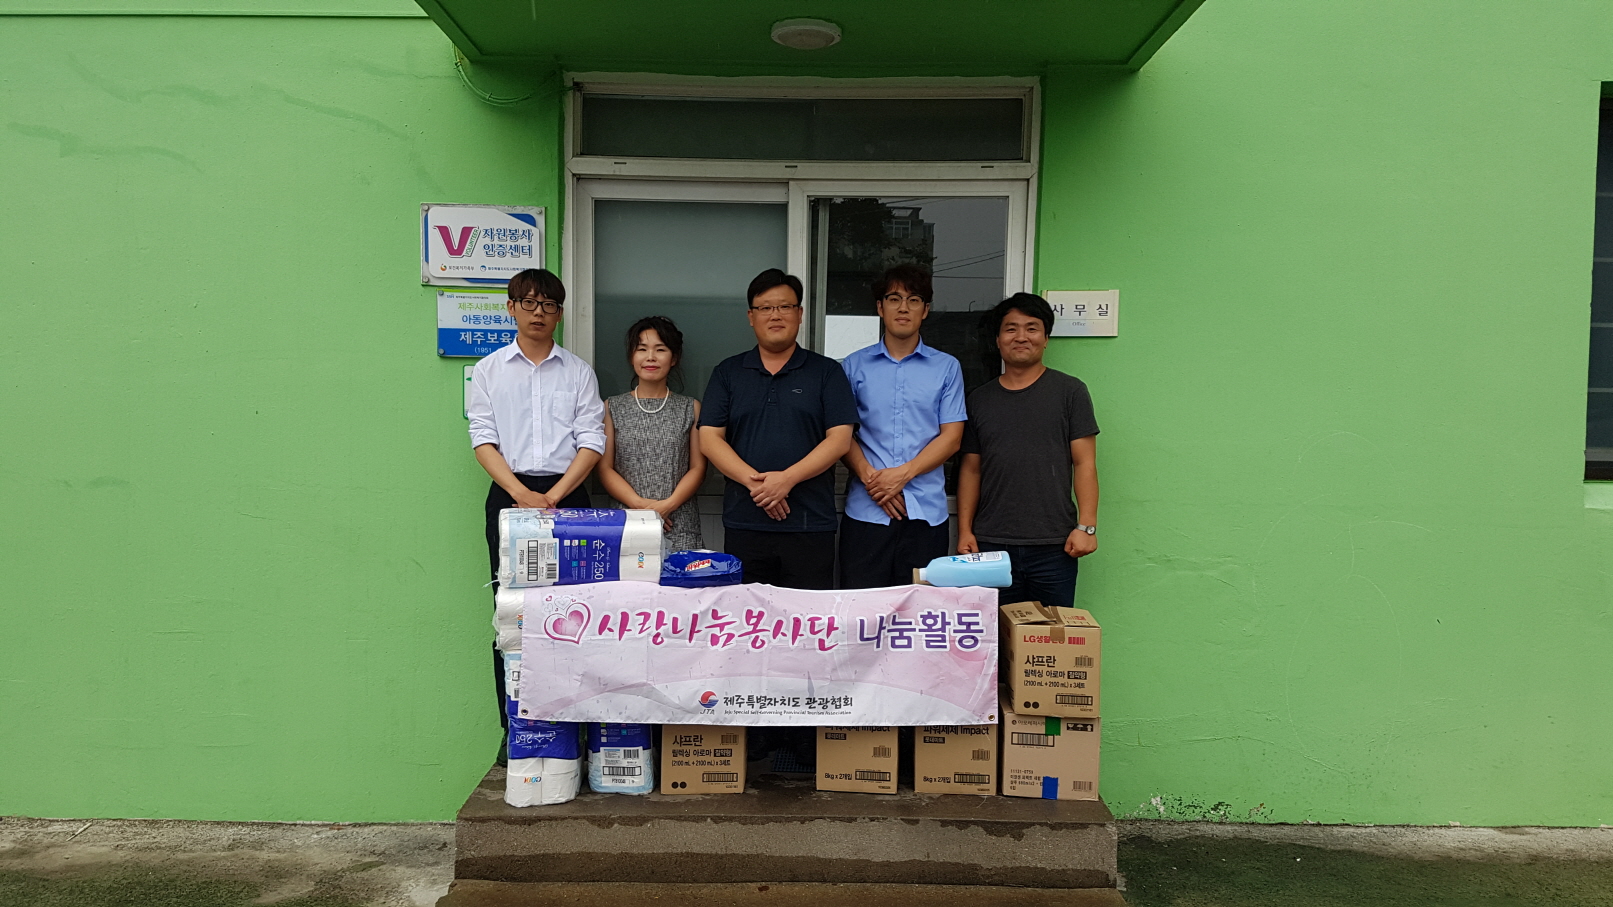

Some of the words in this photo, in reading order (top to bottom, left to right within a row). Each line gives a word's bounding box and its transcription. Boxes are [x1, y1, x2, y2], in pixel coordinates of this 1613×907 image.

[482, 228, 533, 242] 자원봉사
[465, 229, 479, 255] VOLUNTEER
[483, 244, 533, 257] 인증센터
[459, 331, 517, 344] 제주보육
[597, 608, 840, 651] 사랑나눔봉사단
[858, 610, 985, 650] 나눔활동
[1024, 655, 1056, 668] 샤프란
[1046, 670, 1065, 678] 아로마
[723, 694, 801, 709] 제주특별자치도
[805, 695, 853, 709] 관광협회
[960, 726, 990, 736] Impact
[672, 735, 703, 747] 샤프란
[693, 749, 712, 757] 아로마
